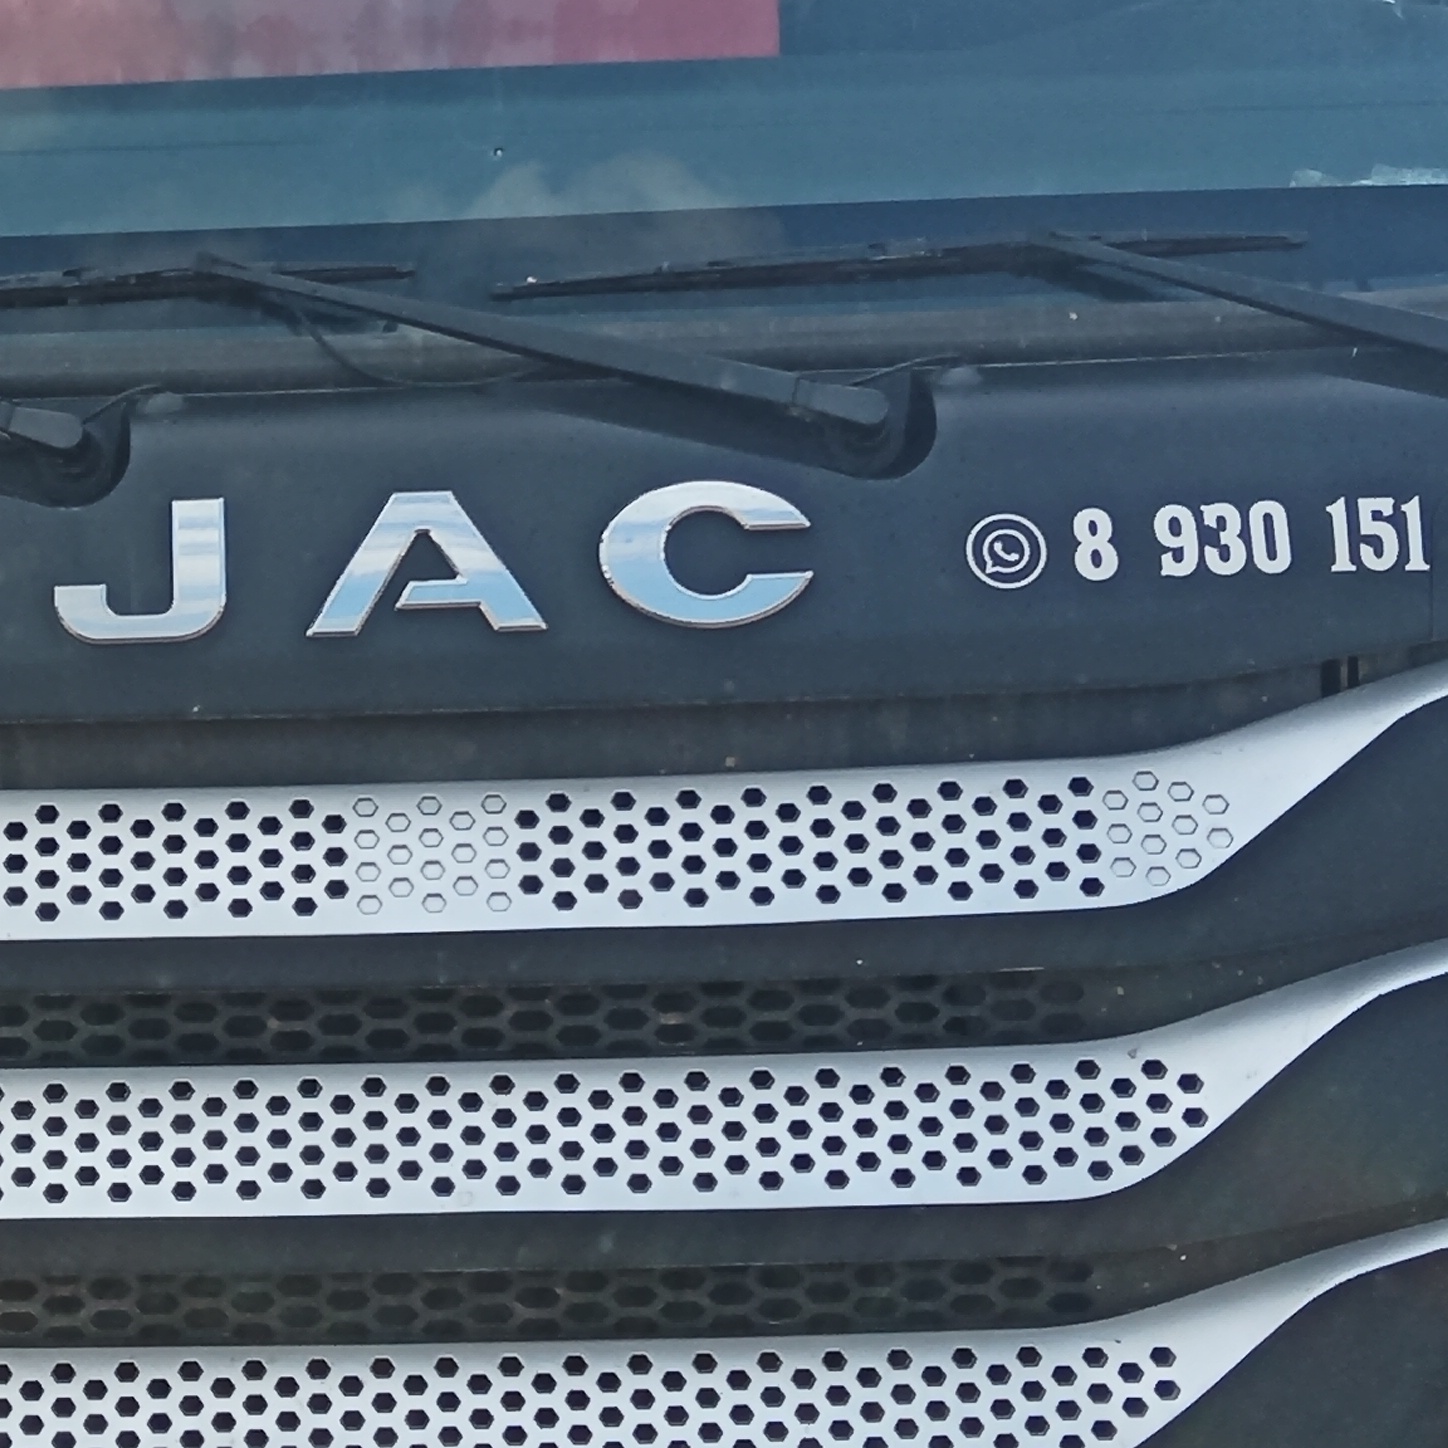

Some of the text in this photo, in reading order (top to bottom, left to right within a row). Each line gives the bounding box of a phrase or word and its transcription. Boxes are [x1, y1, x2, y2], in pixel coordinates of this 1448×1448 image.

[53, 480, 814, 645] JAC
[1072, 507, 1120, 582] 8
[1153, 499, 1293, 578] 930
[1324, 495, 1431, 573] 151
